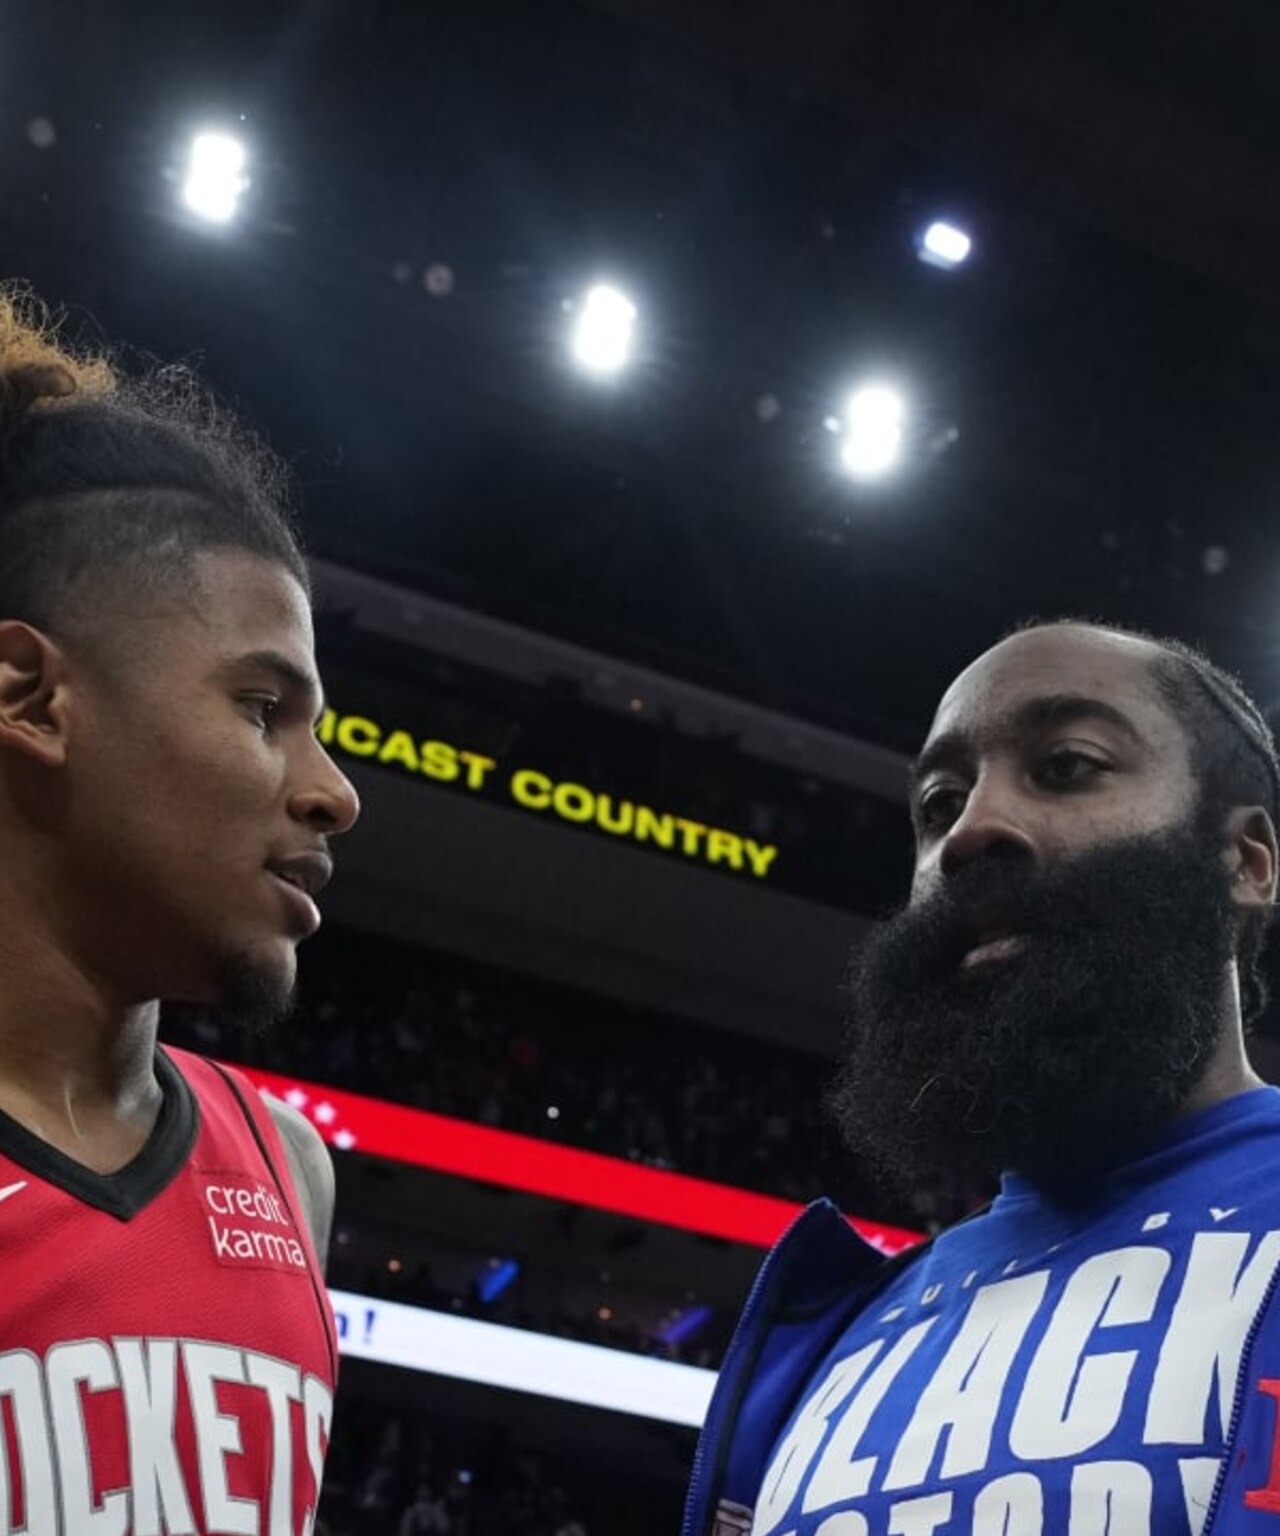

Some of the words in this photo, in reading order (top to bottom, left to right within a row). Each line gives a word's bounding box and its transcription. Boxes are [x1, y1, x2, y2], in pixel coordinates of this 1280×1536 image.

[510, 768, 778, 877] COUNTRY
[205, 1184, 289, 1226] credit
[208, 1216, 307, 1268] karma
